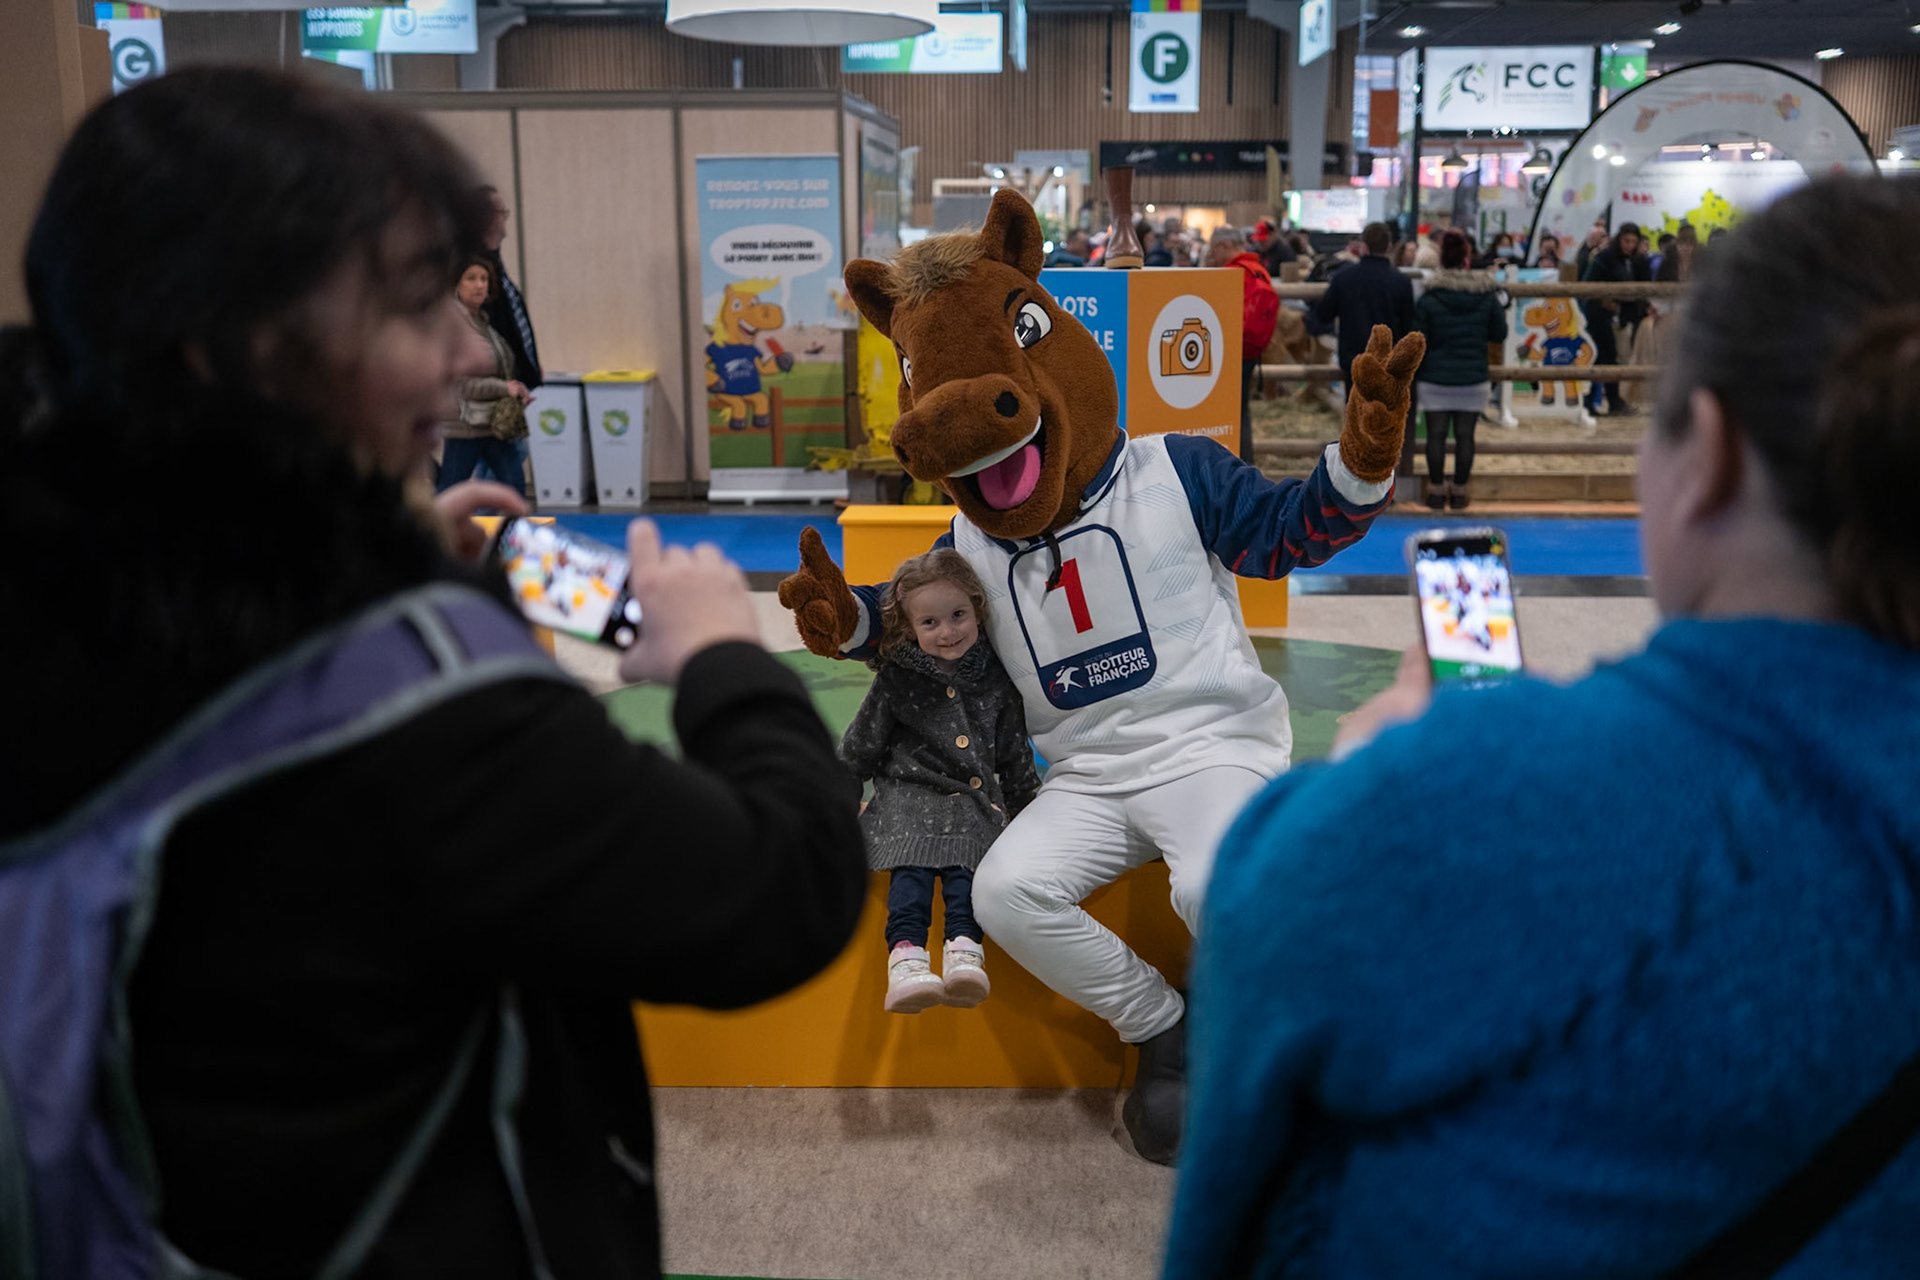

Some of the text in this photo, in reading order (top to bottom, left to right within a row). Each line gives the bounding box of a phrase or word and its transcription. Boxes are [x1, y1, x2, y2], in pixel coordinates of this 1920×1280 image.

[117, 45, 152, 80] G
[1153, 38, 1180, 78] F
[1503, 62, 1577, 89] FCC
[1045, 557, 1094, 634] 1
[1084, 647, 1146, 676] TROTTEUR
[1088, 657, 1150, 687] FRANÇAIS
